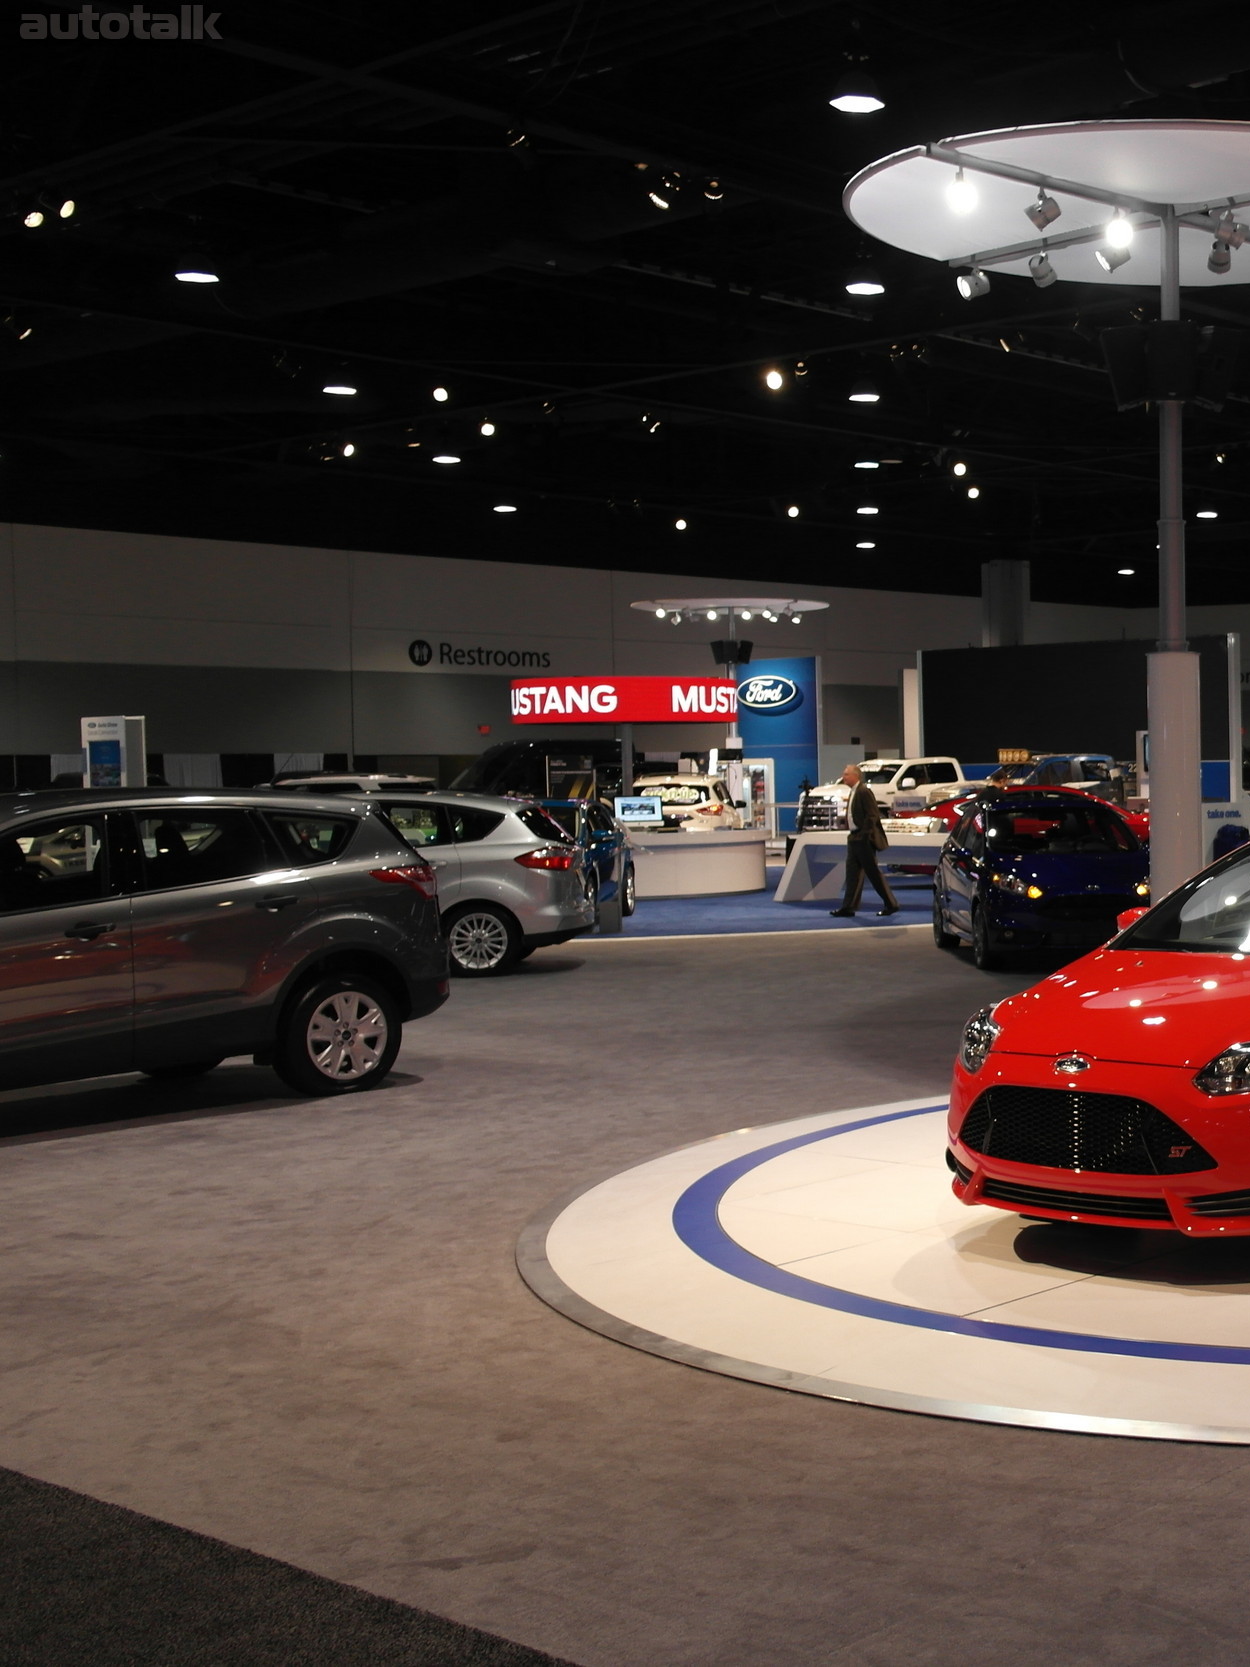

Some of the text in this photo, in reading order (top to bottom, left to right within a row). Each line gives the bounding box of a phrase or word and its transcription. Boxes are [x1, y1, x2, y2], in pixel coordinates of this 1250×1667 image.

[440, 642, 551, 668] Restrooms
[745, 679, 783, 703] Ford
[1168, 1146, 1192, 1158] ST
